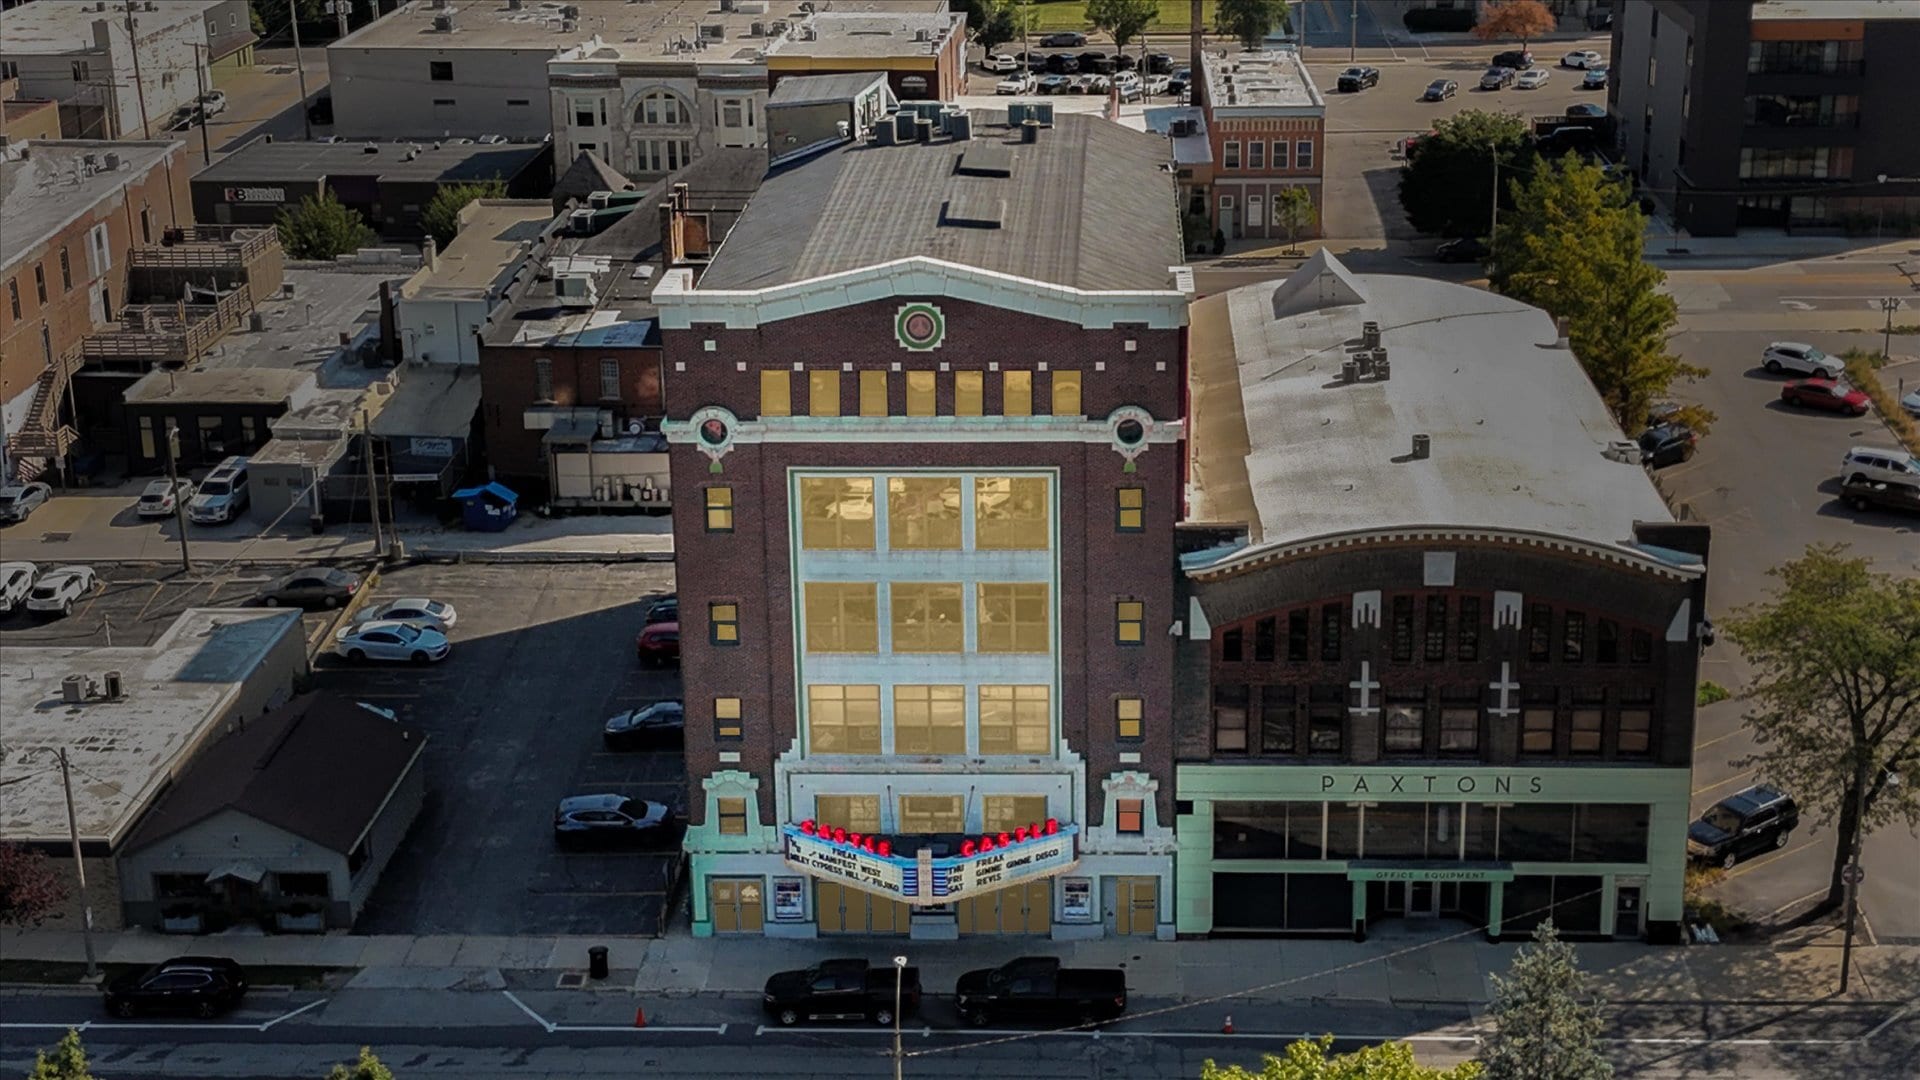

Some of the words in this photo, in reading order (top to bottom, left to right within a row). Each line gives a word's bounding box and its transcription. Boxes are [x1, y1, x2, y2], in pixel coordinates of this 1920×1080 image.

[1321, 776, 1542, 793] PAXTONS
[801, 819, 892, 857] CASTLE
[961, 818, 1057, 857] CASTLE
[812, 861, 843, 875] CYPRESS
[845, 870, 860, 881] HILL
[819, 853, 856, 869] MANIFEST
[861, 866, 882, 878] WEST
[948, 865, 964, 874] THU
[976, 855, 1004, 867] FREAK
[948, 875, 962, 884] FRI
[1035, 849, 1058, 861] DISCO
[1376, 871, 1415, 879] OFFICE
[1424, 871, 1486, 879] EQUIPMENT
[949, 883, 964, 892] SAT
